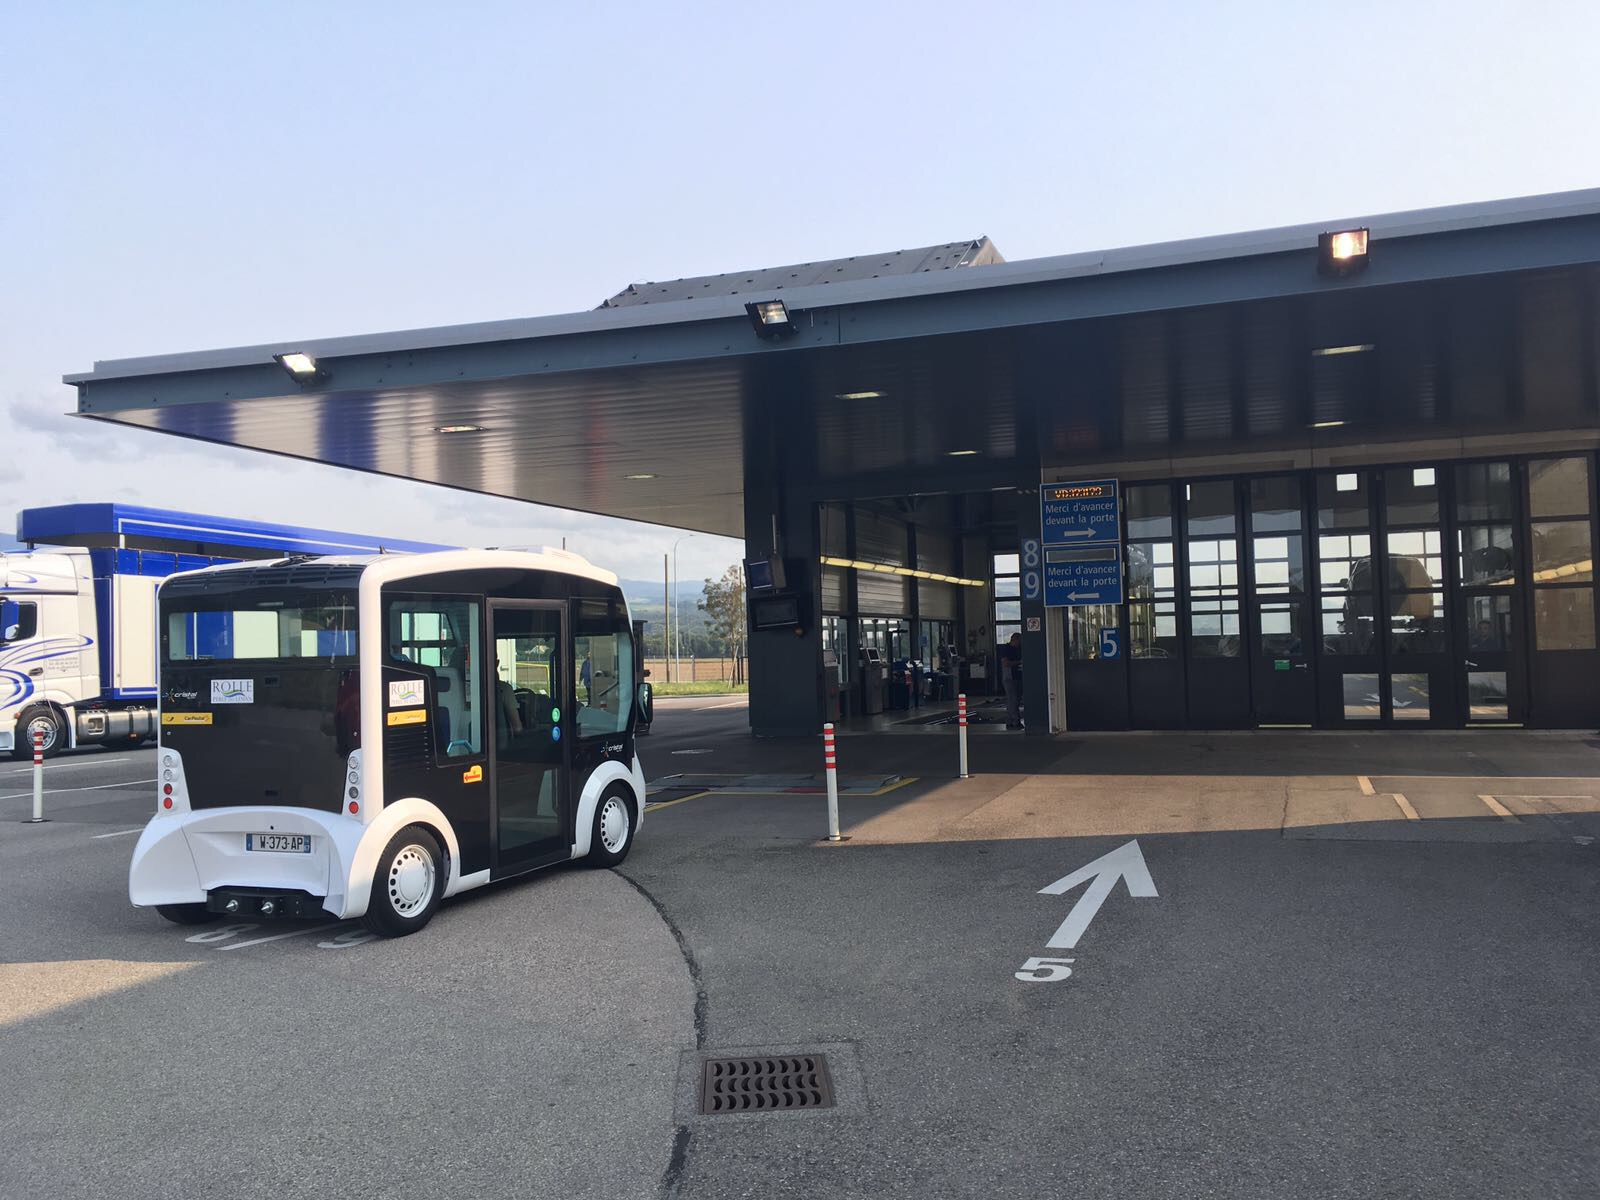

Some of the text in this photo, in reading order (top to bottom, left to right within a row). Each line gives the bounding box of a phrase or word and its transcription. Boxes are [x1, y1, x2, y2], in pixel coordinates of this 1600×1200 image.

[1045, 502, 1114, 513] Merci d'avancer
[1045, 514, 1114, 525] devant la porte
[1024, 540, 1039, 567] 8
[1048, 565, 1116, 576] Merci d'avancer
[1024, 572, 1039, 599] 9
[1048, 576, 1117, 588] devant la porte
[1103, 630, 1117, 657] 5
[212, 681, 253, 693] ROLLE
[1015, 957, 1075, 982] 5
